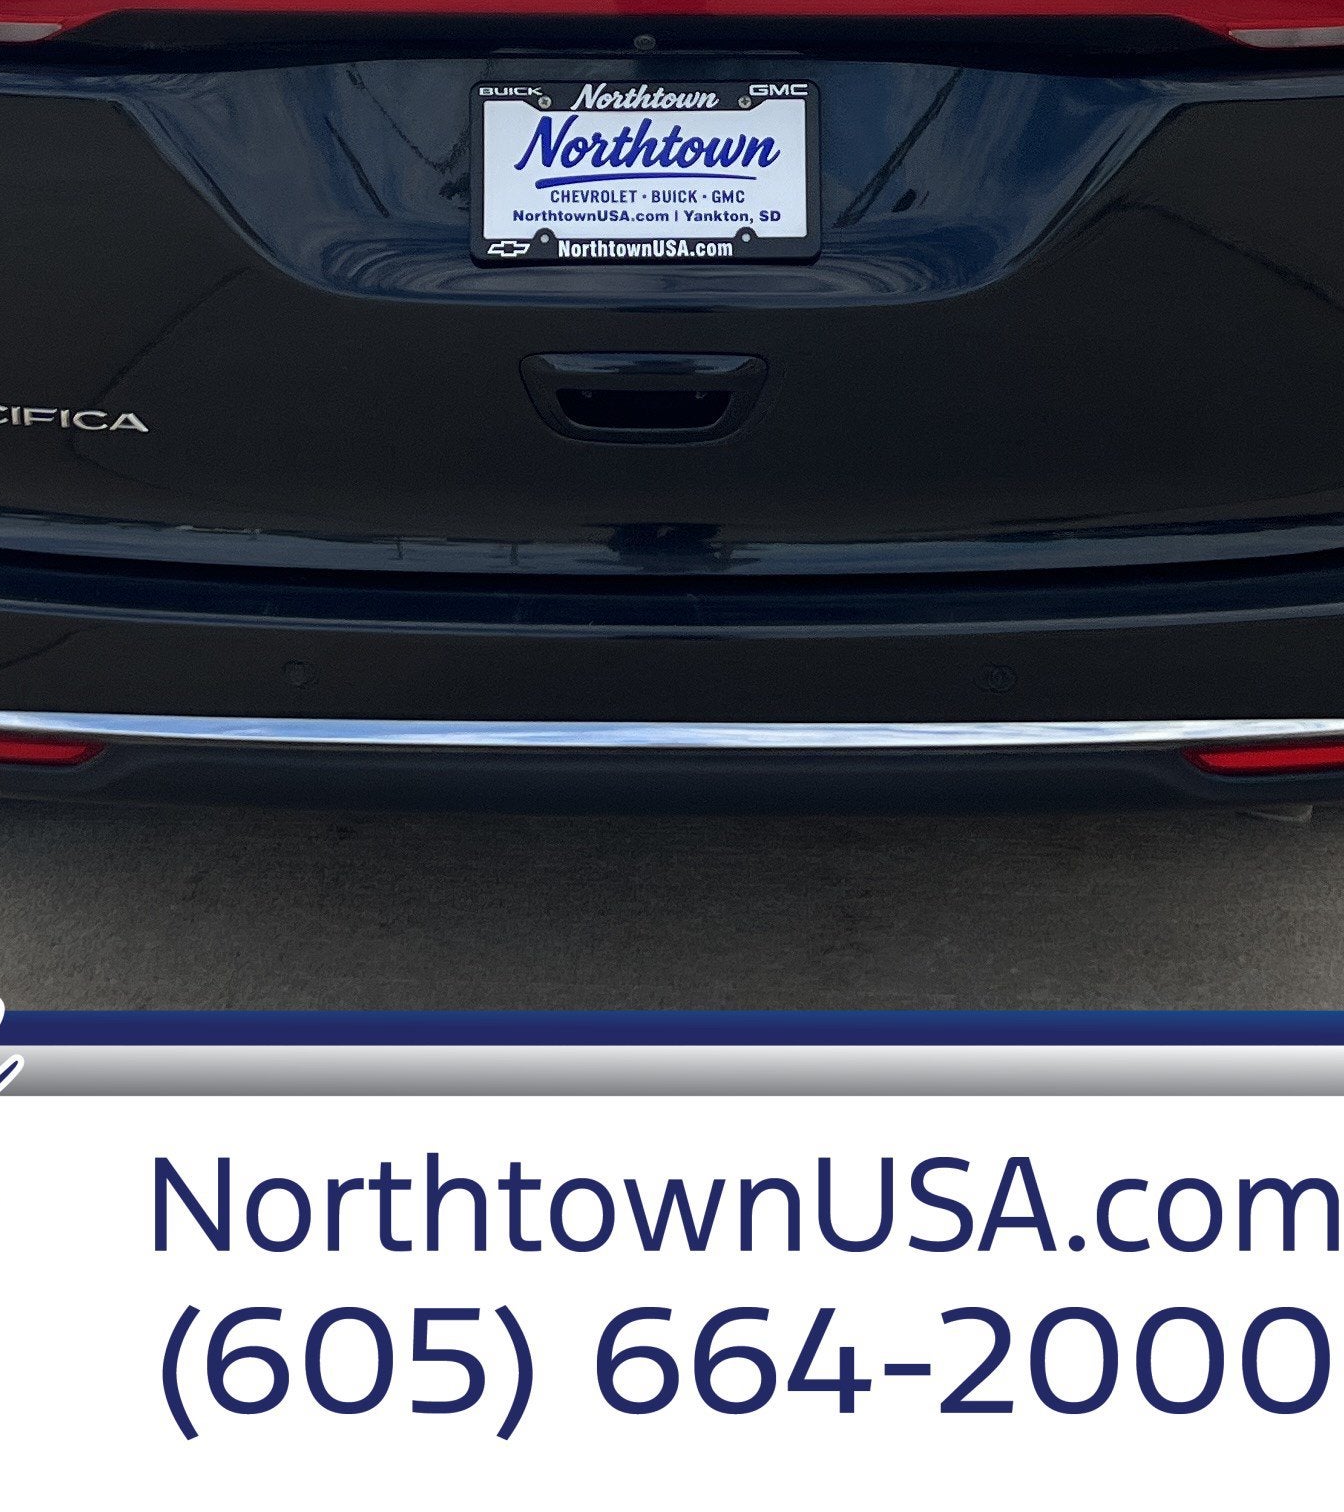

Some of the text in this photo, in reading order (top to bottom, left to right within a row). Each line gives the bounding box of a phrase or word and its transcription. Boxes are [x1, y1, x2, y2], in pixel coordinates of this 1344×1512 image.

[479, 87, 543, 96] BUICK
[570, 83, 720, 110] Northtown
[749, 83, 808, 96] GMC
[514, 114, 781, 171] Northtown
[550, 189, 746, 204] CHEVROLET BUICK GMC
[513, 209, 781, 224] NorthtownUSA.com Yankton, SD
[558, 239, 733, 258] NorthtownUSA.com
